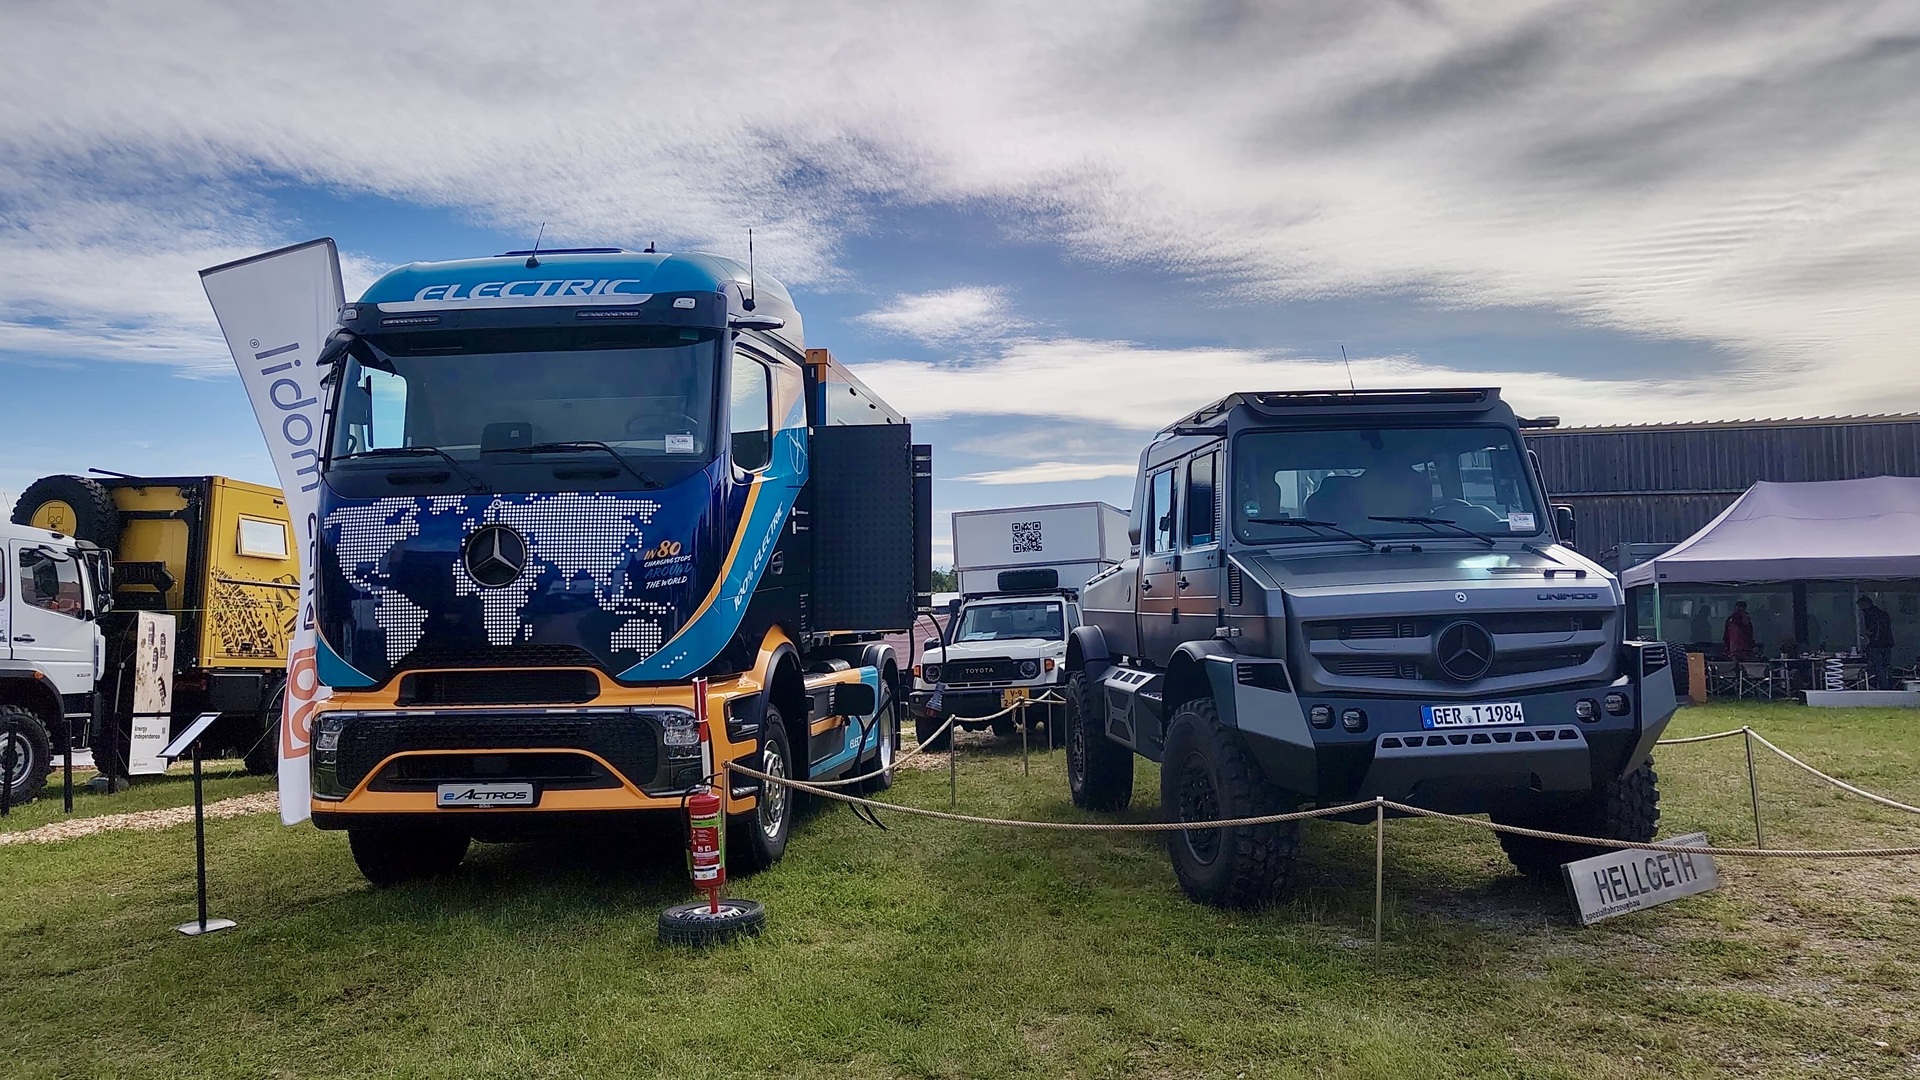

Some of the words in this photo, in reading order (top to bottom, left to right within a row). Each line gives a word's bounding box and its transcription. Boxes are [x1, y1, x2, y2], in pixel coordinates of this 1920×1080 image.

[414, 279, 640, 300] ELECTRIC
[644, 548, 657, 560] IN
[657, 540, 681, 557] 80
[734, 565, 753, 611] 100%
[754, 501, 783, 570] ELECTRIC
[644, 558, 673, 567] CHARGING
[674, 555, 691, 563] STOPS
[645, 563, 692, 579] AROUND
[646, 580, 661, 589] THE
[661, 576, 687, 586] WORLD
[1433, 707, 1462, 724] GER
[1472, 707, 1481, 723] T
[1486, 705, 1522, 722] 1984
[1593, 853, 1697, 904] HELLGETH
